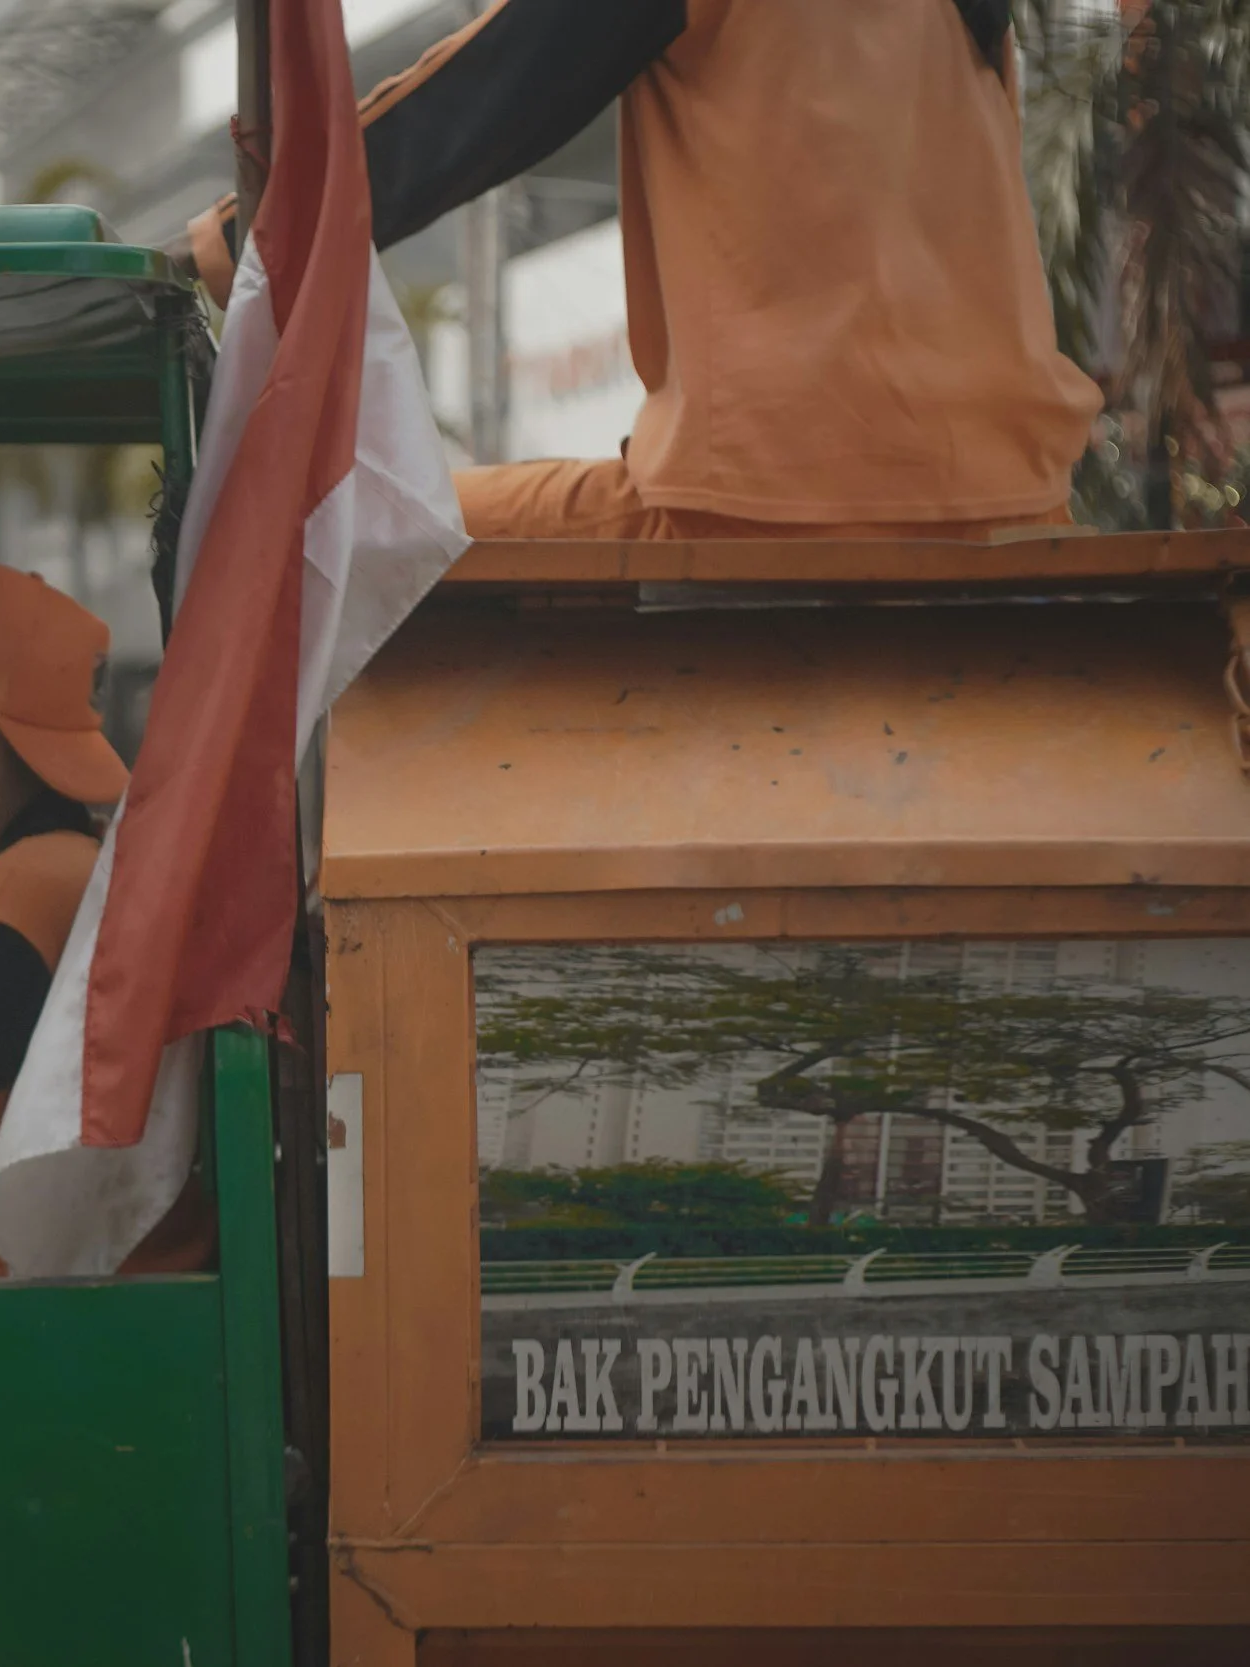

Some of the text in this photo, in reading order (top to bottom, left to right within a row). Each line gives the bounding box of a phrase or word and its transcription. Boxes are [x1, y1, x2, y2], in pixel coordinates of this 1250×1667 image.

[512, 1333, 1250, 1432] BAK PENGANGKUT SAMPAH
